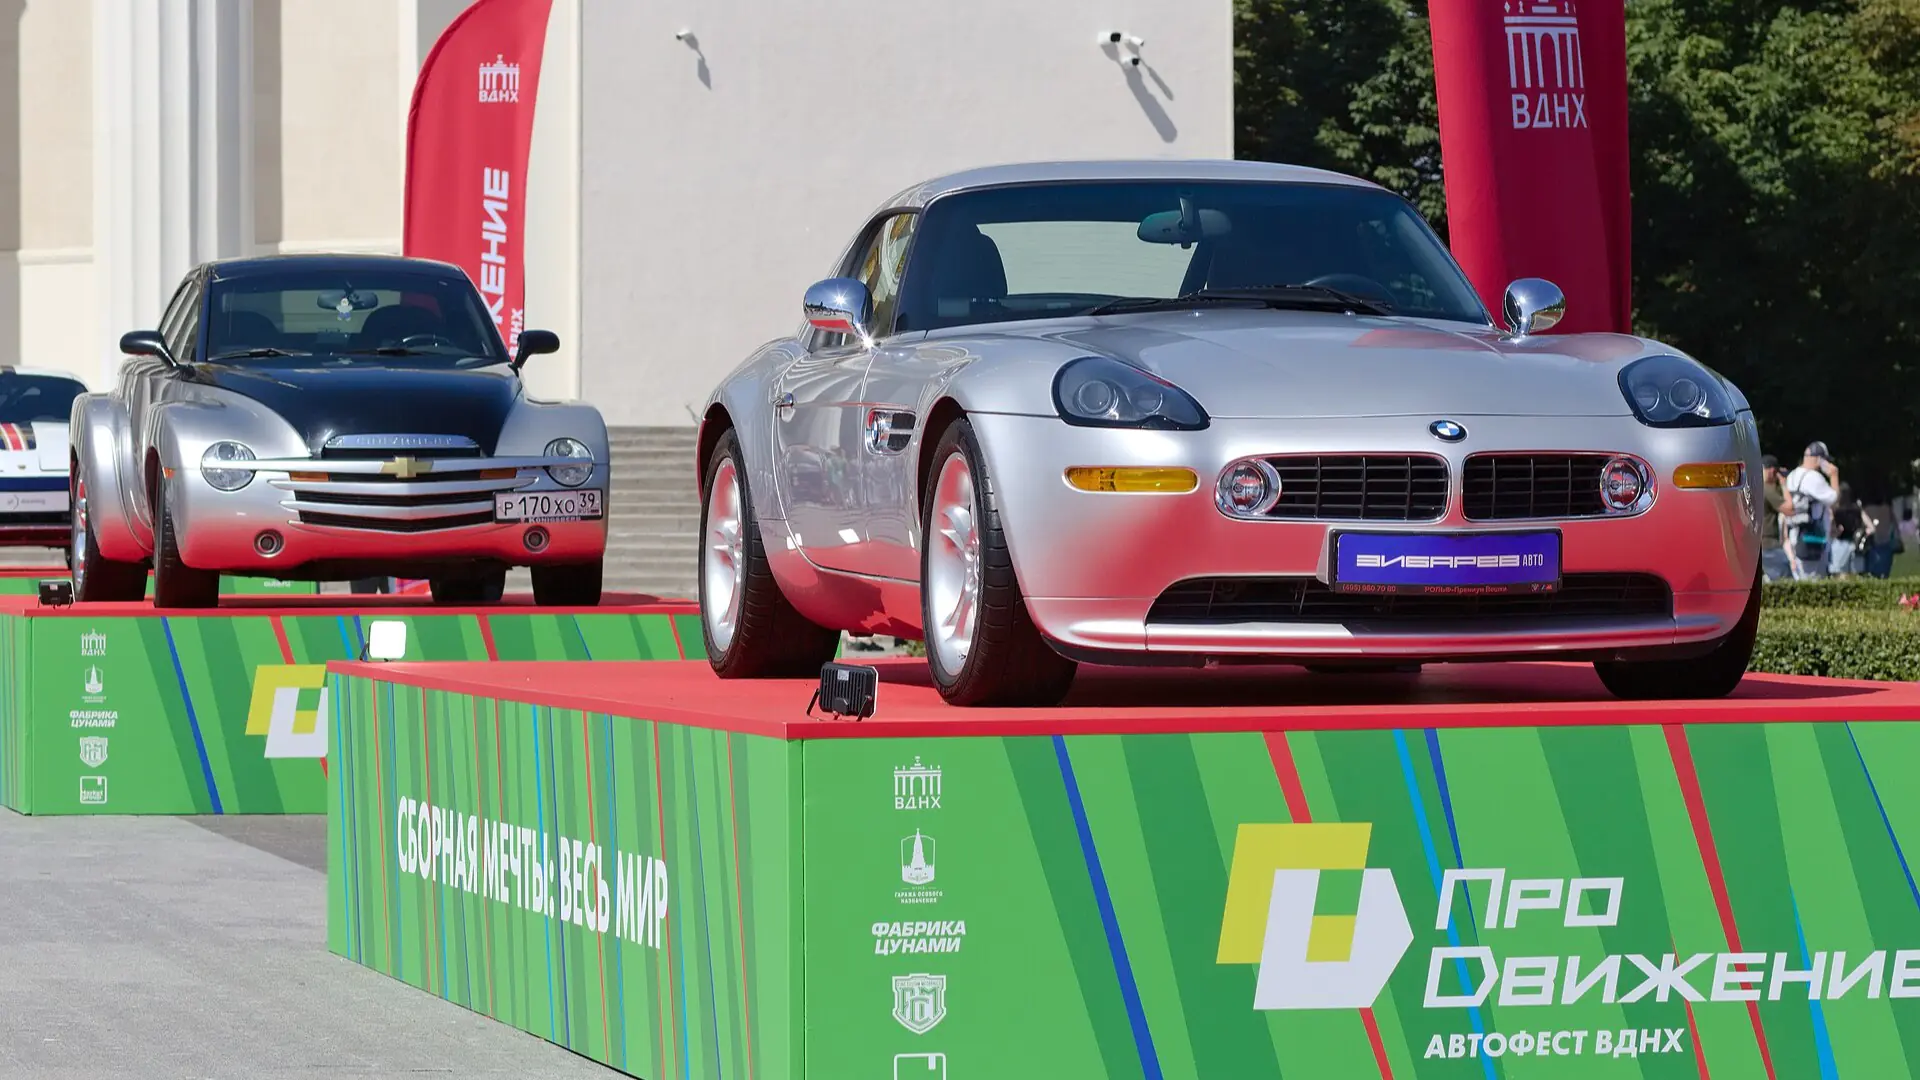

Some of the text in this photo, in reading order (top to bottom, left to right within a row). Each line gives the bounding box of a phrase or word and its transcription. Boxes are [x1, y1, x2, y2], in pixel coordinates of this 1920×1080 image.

[478, 90, 519, 103] ВДНХ
[1511, 93, 1588, 129] ВДНХ
[580, 493, 595, 508] 39
[1522, 553, 1544, 567] АВТО
[81, 648, 106, 656] ВДНХ
[69, 710, 118, 719] ФАБРИКА
[71, 719, 116, 728] ЦУНАМИ
[895, 796, 942, 809] ВДНХ
[397, 795, 668, 950] СБОРНАЯ МЕЧТЫ: ВЕСЬ МИР
[871, 920, 966, 937] ФАБРИКА
[875, 937, 961, 956] ЦУНАМИ
[1424, 1028, 1684, 1059] АВТОФЕСТ ВДНХ
